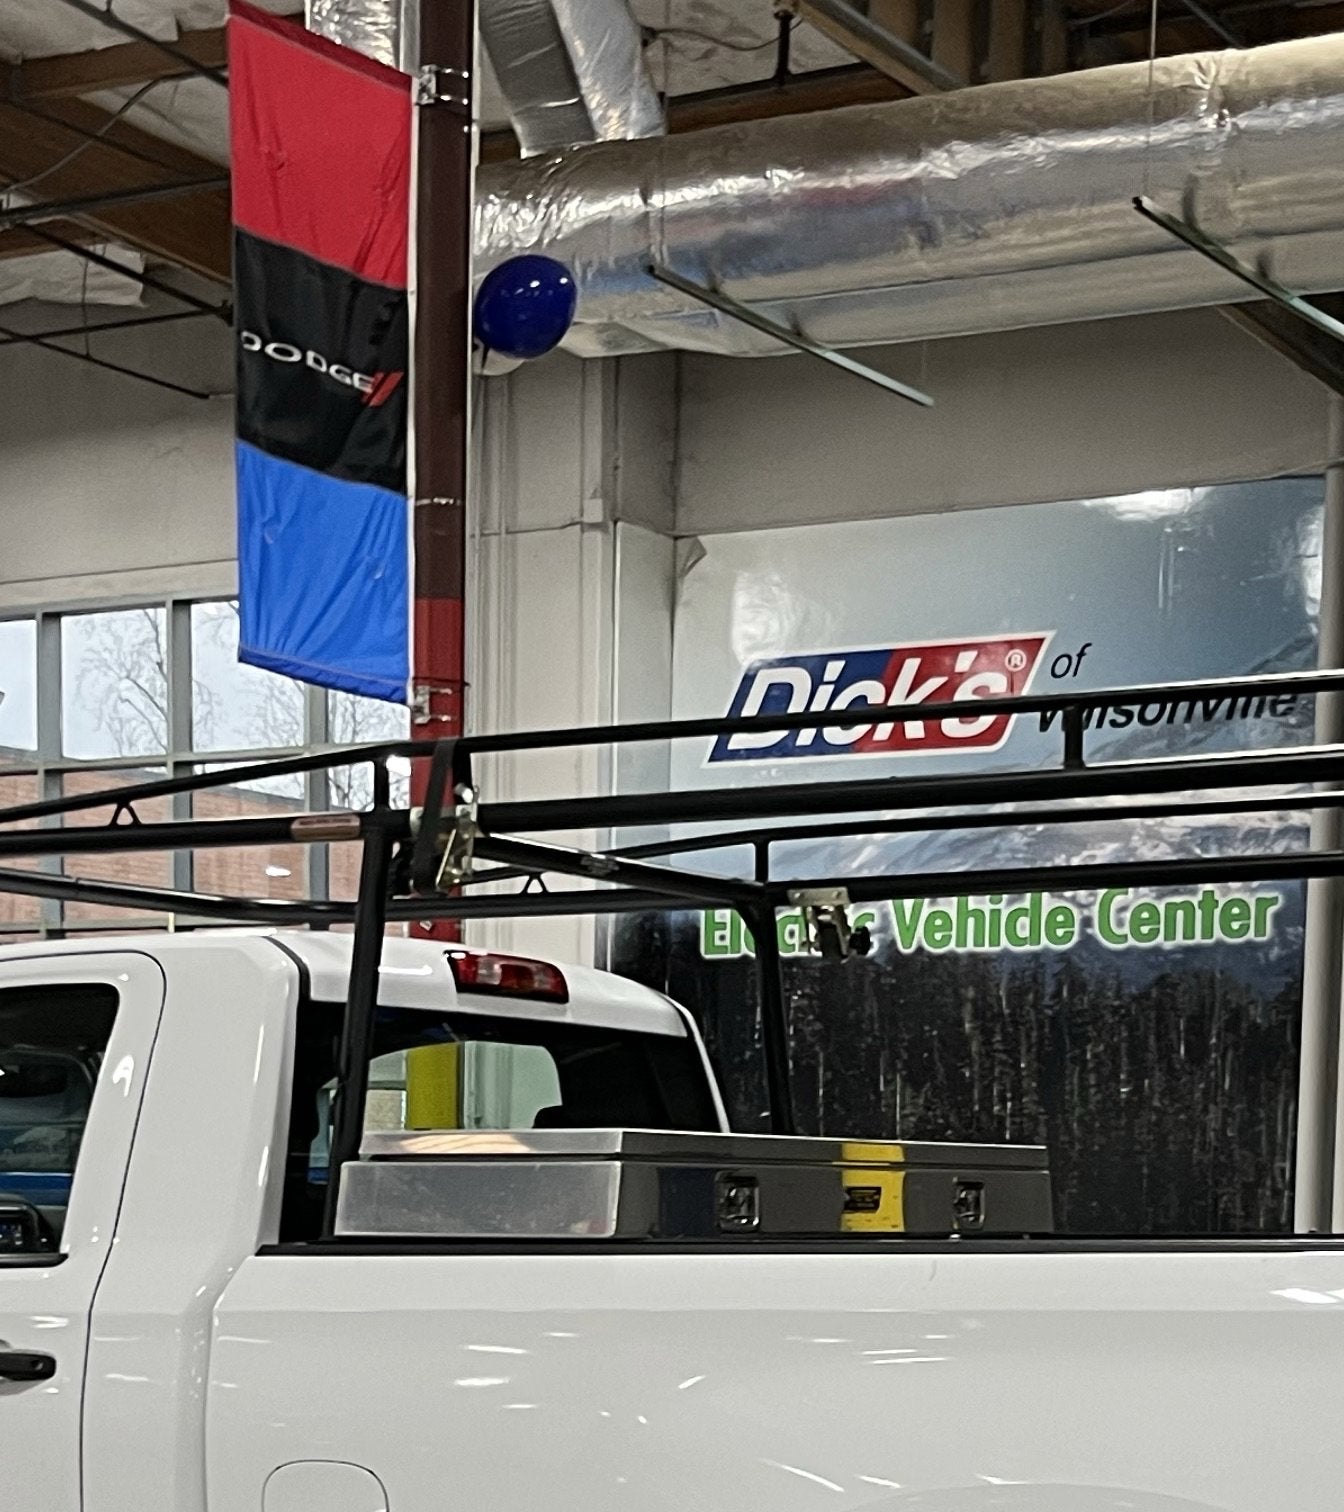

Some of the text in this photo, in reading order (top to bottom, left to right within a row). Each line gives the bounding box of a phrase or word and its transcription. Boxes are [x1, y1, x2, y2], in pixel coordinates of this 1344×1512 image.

[240, 330, 375, 394] DODGE
[727, 643, 1093, 750] Dick's of
[892, 890, 1076, 950] Vehicle
[1097, 886, 1280, 946] Center
